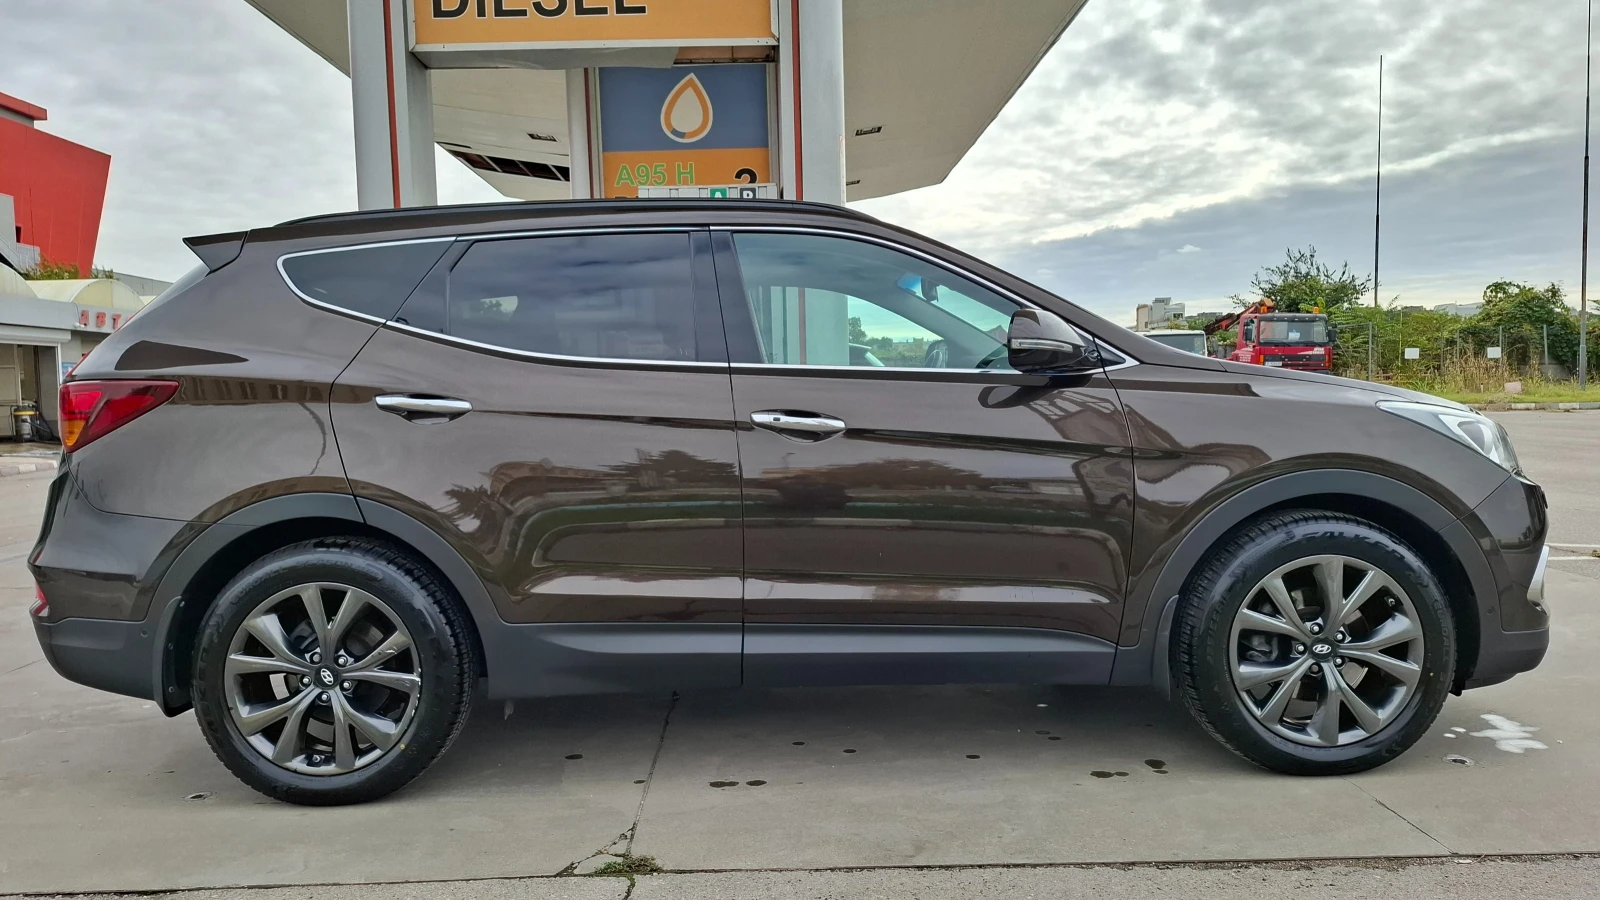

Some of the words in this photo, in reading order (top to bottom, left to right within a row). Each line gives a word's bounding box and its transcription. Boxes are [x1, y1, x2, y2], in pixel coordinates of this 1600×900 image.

[614, 162, 668, 187] A95
[675, 161, 696, 186] H
[79, 309, 134, 330] АВТ
